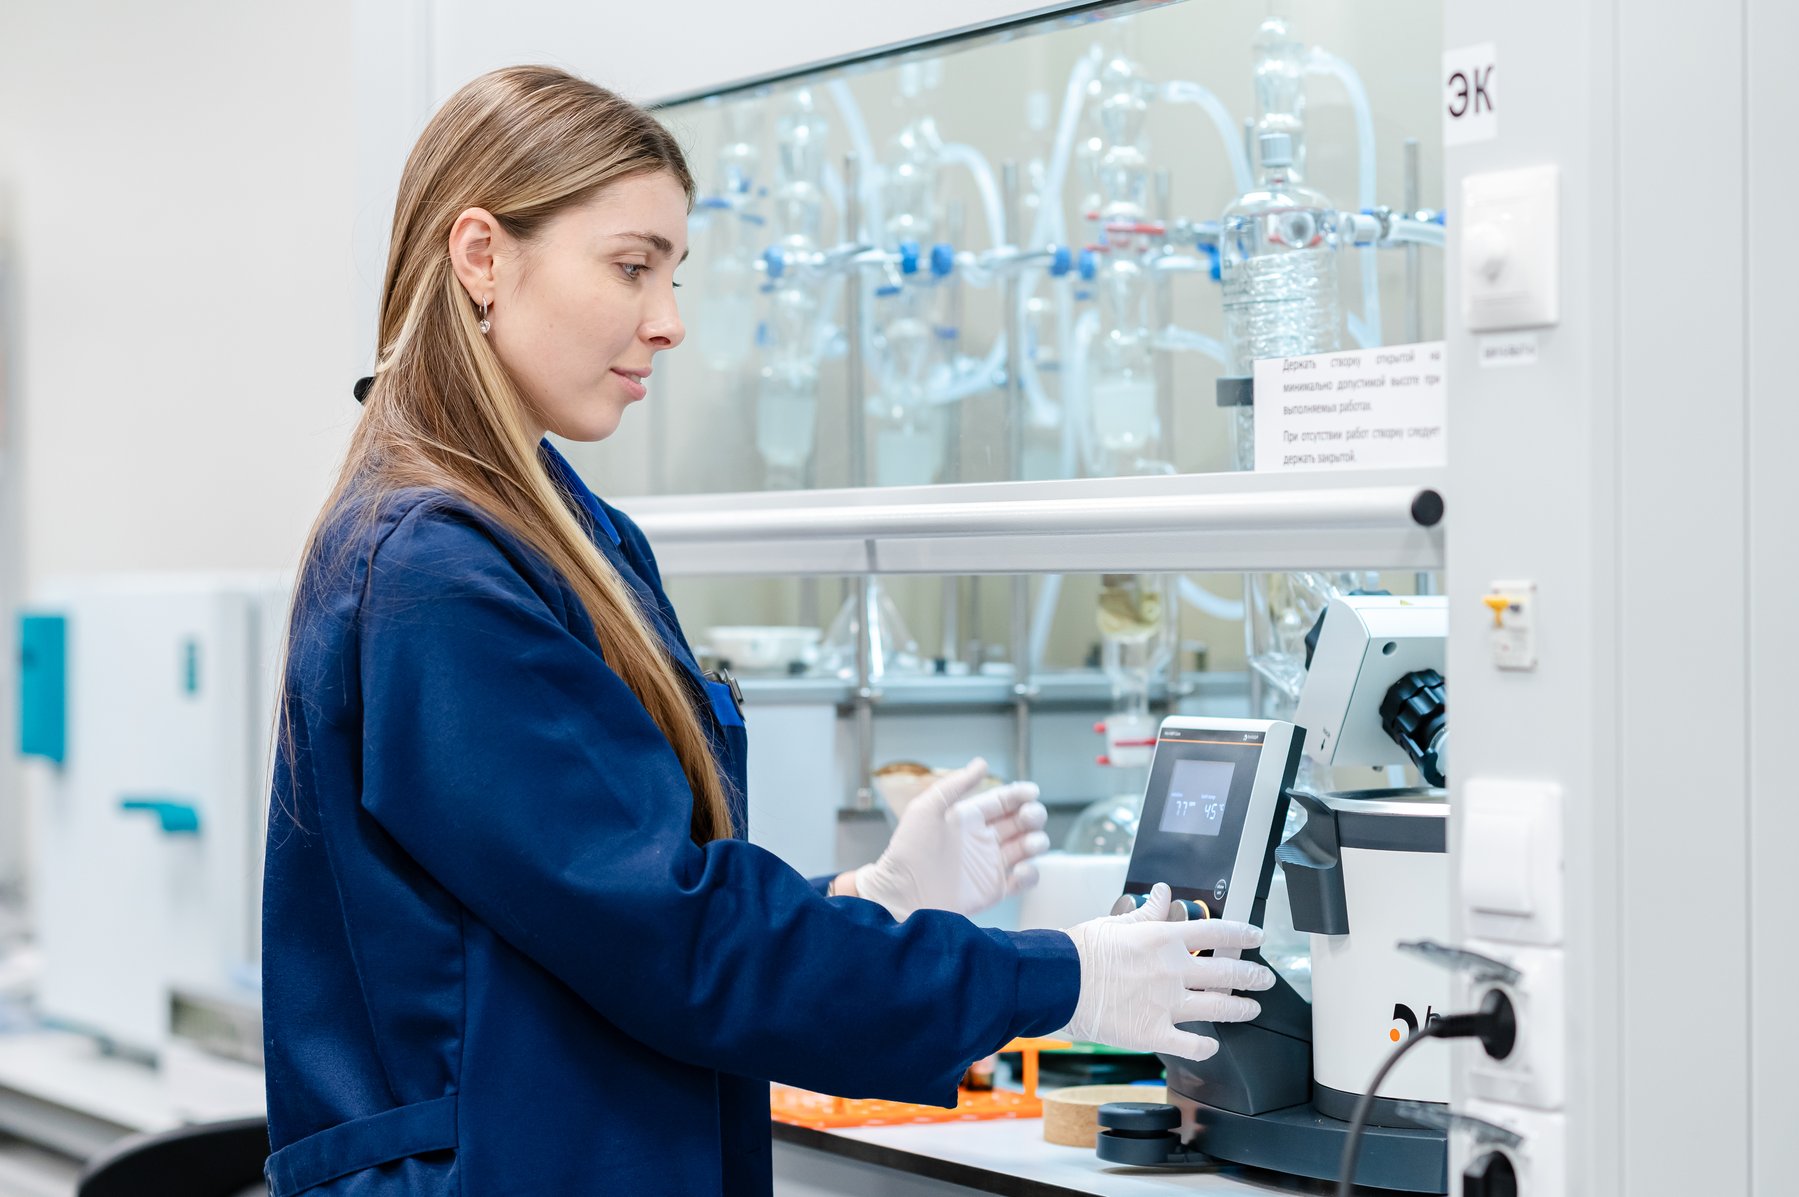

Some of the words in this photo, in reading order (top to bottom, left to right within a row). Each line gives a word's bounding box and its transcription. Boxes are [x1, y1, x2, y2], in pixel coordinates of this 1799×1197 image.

[1447, 63, 1495, 118] ЭК
[1282, 359, 1316, 372] Держать
[1330, 357, 1361, 369] створку
[1376, 350, 1415, 365] открытой
[1283, 380, 1333, 393] минимально
[1337, 375, 1385, 391] допустимой
[1283, 403, 1337, 416] выполняемых
[1283, 430, 1298, 444] При
[1301, 430, 1343, 443] отсутствии
[1345, 427, 1369, 441] работ
[1283, 453, 1316, 467] держать
[1176, 800, 1188, 816] 77
[1204, 803, 1218, 820] 45
